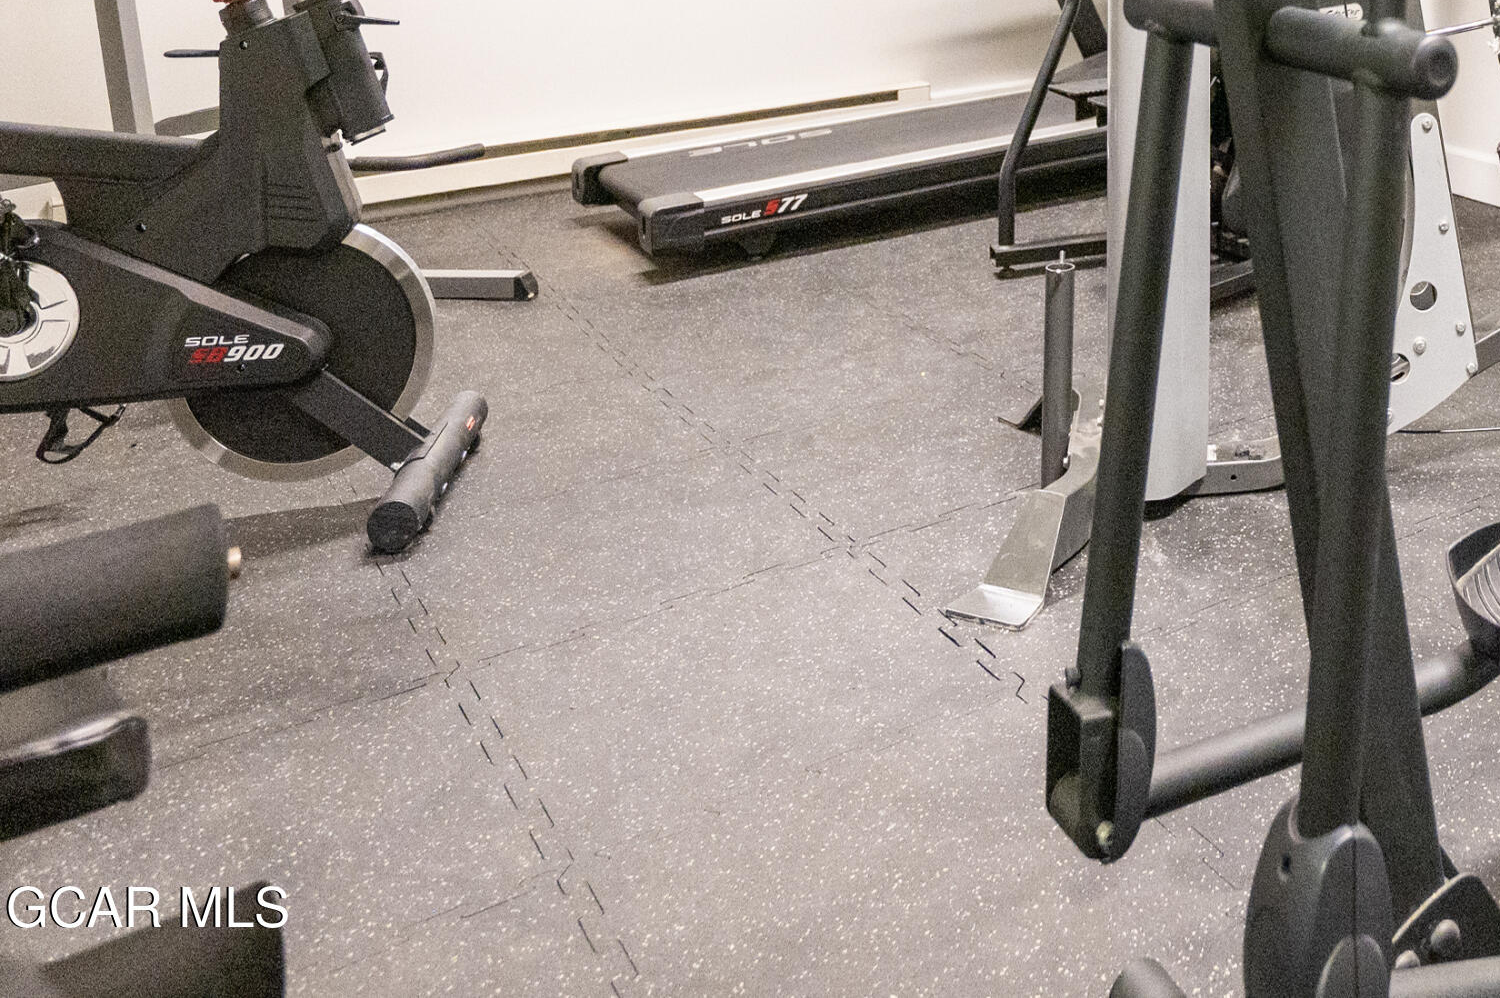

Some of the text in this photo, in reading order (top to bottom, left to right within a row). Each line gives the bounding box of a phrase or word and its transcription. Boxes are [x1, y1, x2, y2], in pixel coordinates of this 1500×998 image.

[721, 193, 808, 224] SOLE S77
[184, 334, 249, 347] SOLE
[189, 343, 284, 363] SB900
